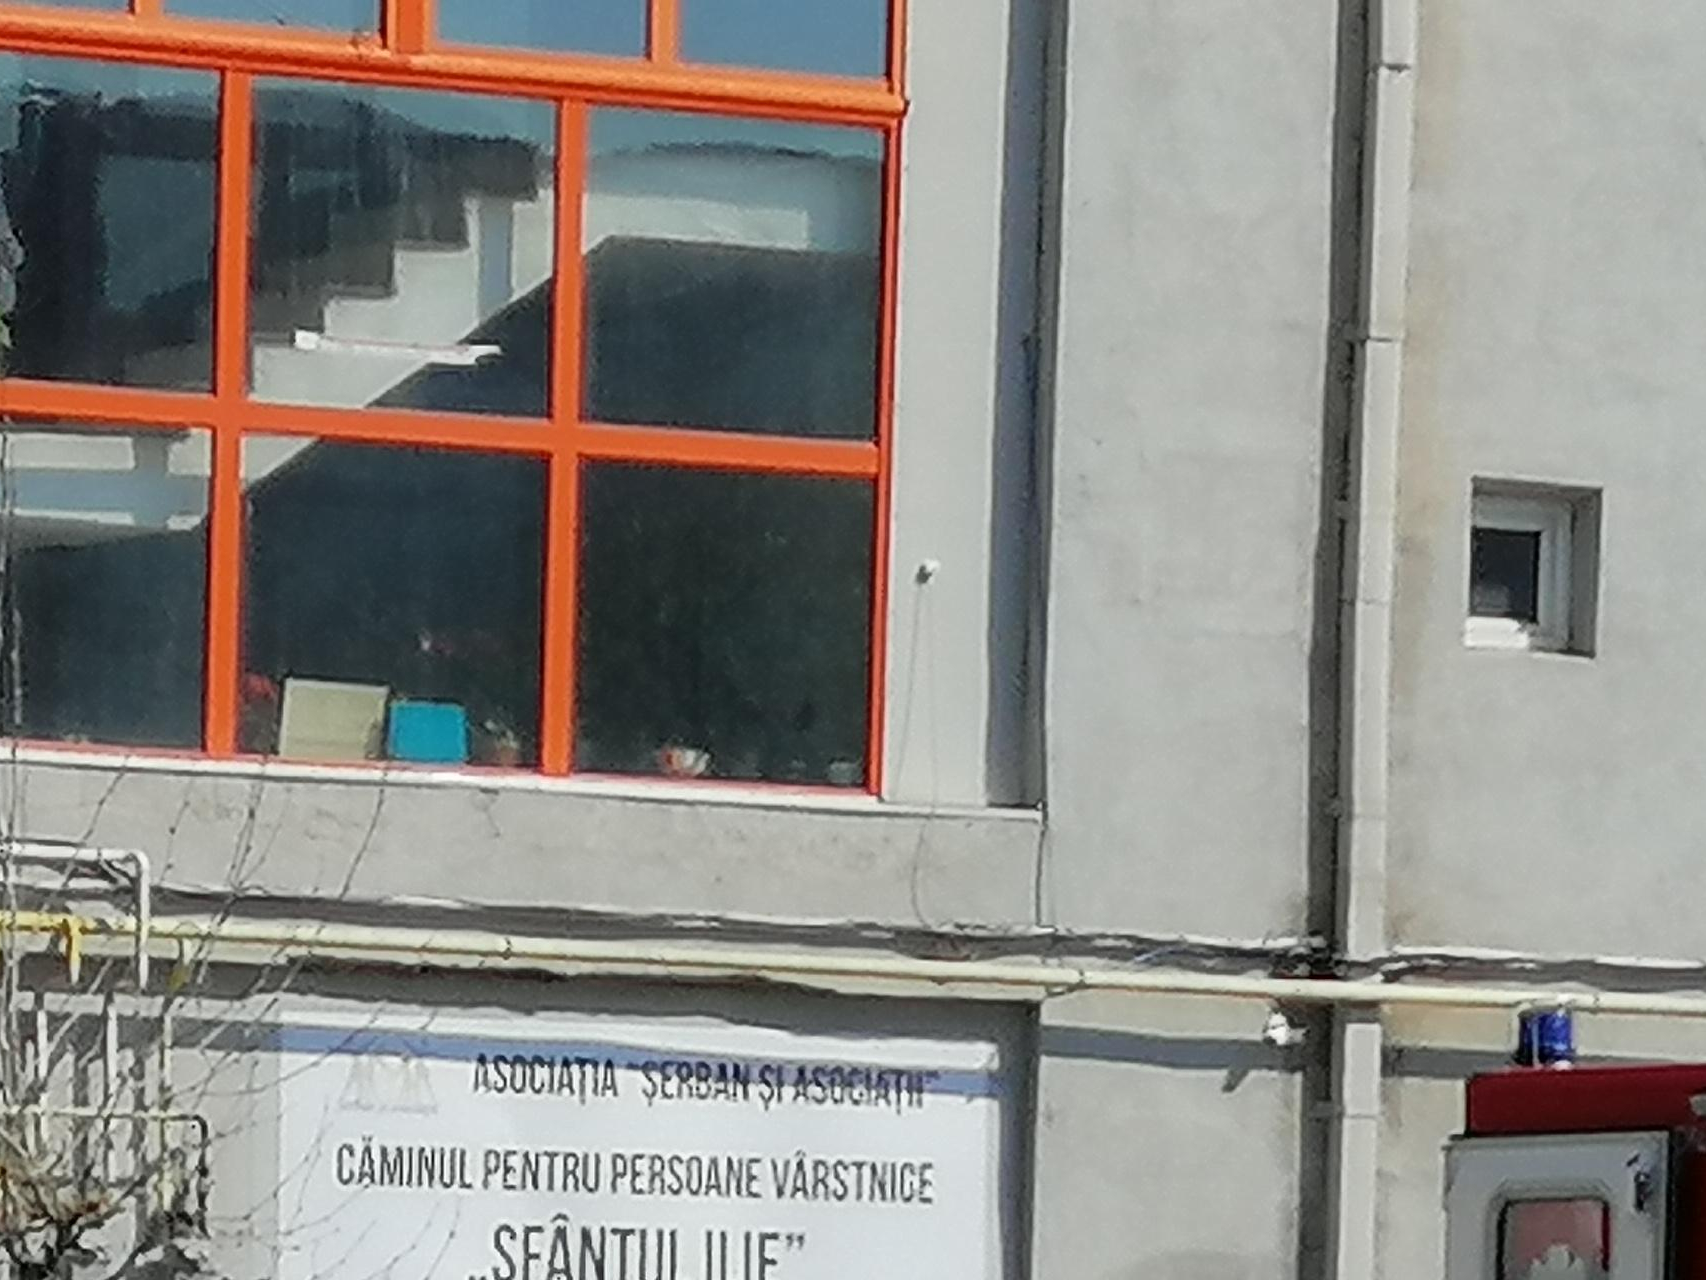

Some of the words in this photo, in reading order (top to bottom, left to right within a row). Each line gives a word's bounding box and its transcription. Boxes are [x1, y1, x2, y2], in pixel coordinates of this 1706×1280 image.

[336, 1135, 474, 1190] CĂMINUL
[482, 1148, 602, 1194] PENTRU
[610, 1151, 764, 1199] PERSOANE
[770, 1149, 935, 1205] VÂRSTNICE
